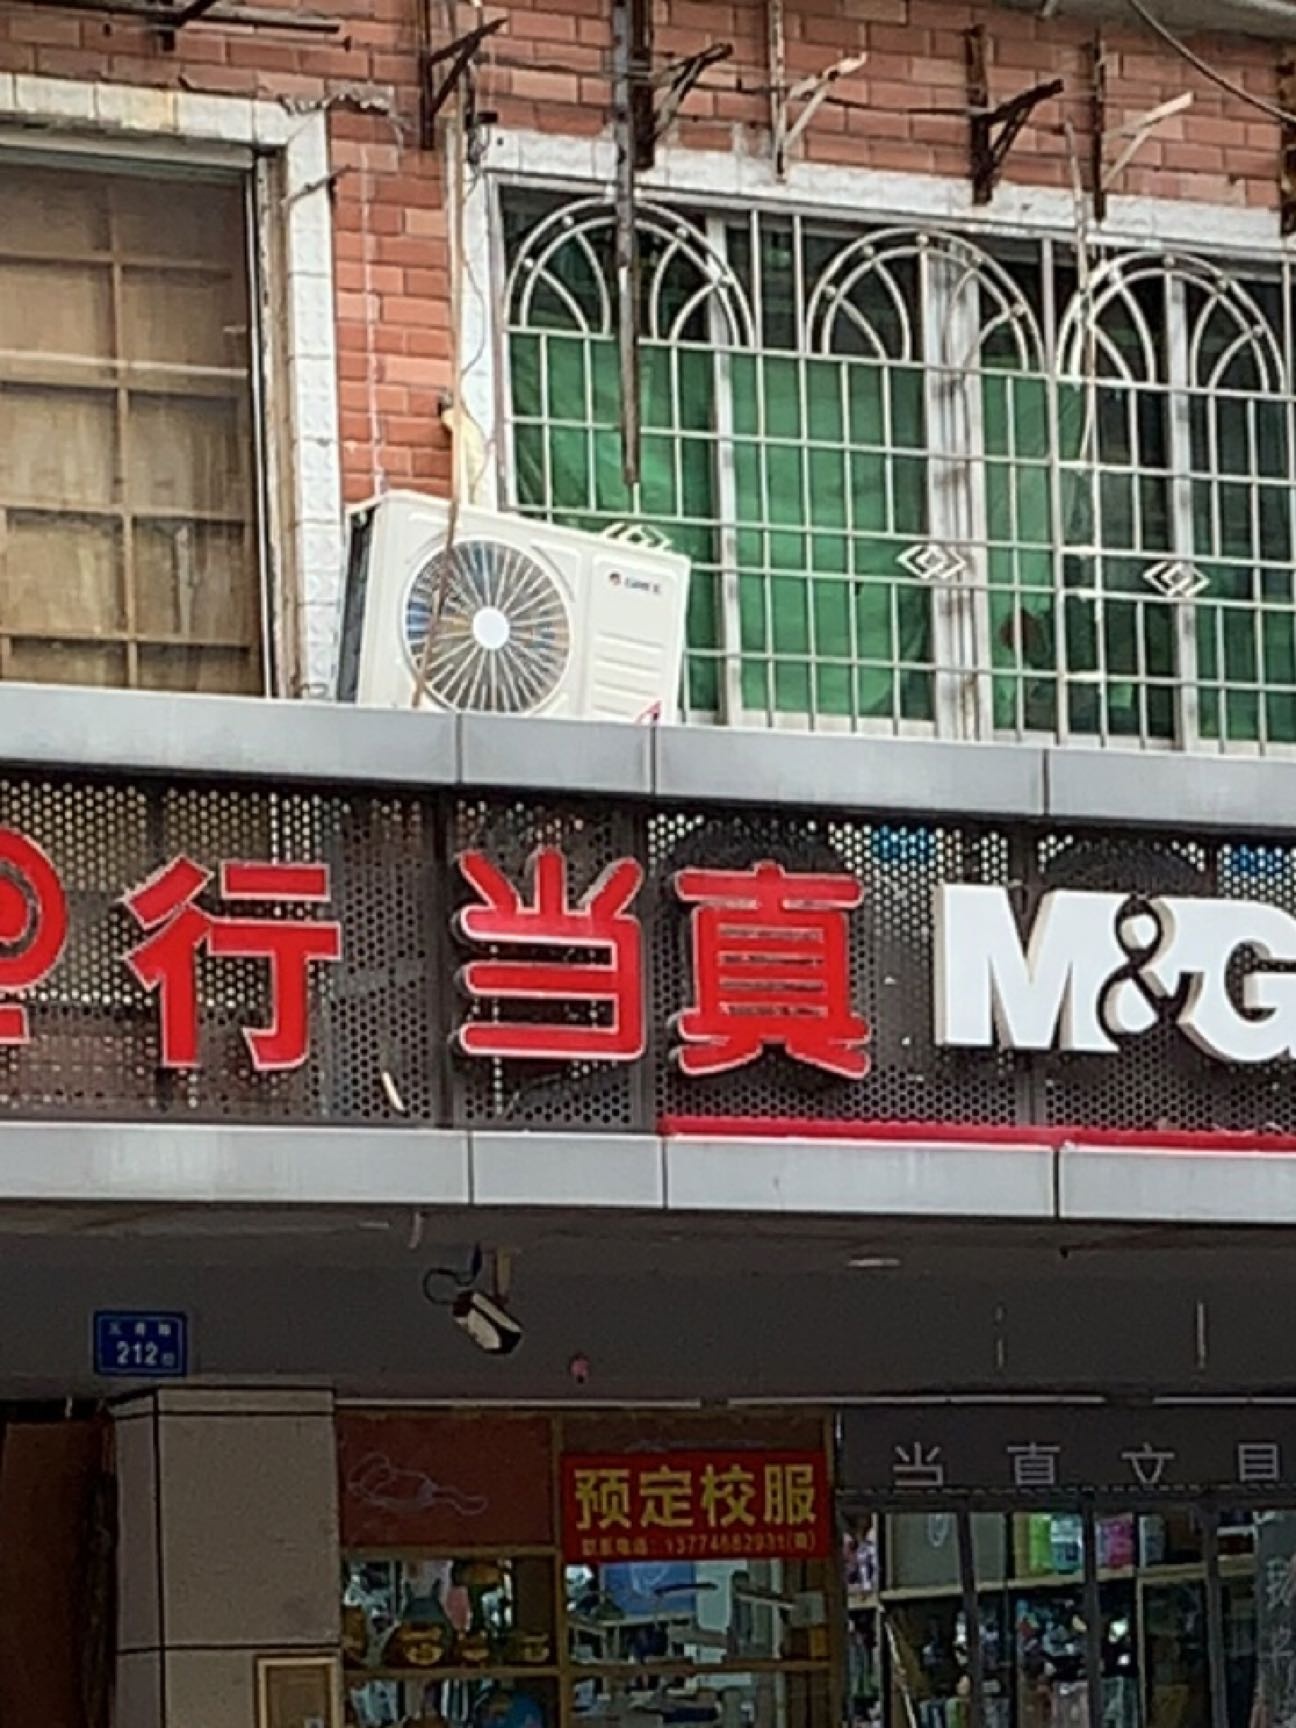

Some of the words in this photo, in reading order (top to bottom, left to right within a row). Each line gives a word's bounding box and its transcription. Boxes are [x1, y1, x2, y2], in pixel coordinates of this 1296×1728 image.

[120, 854, 342, 1070] 行
[455, 845, 872, 1081] 当真
[574, 1463, 816, 1530] 预定校服
